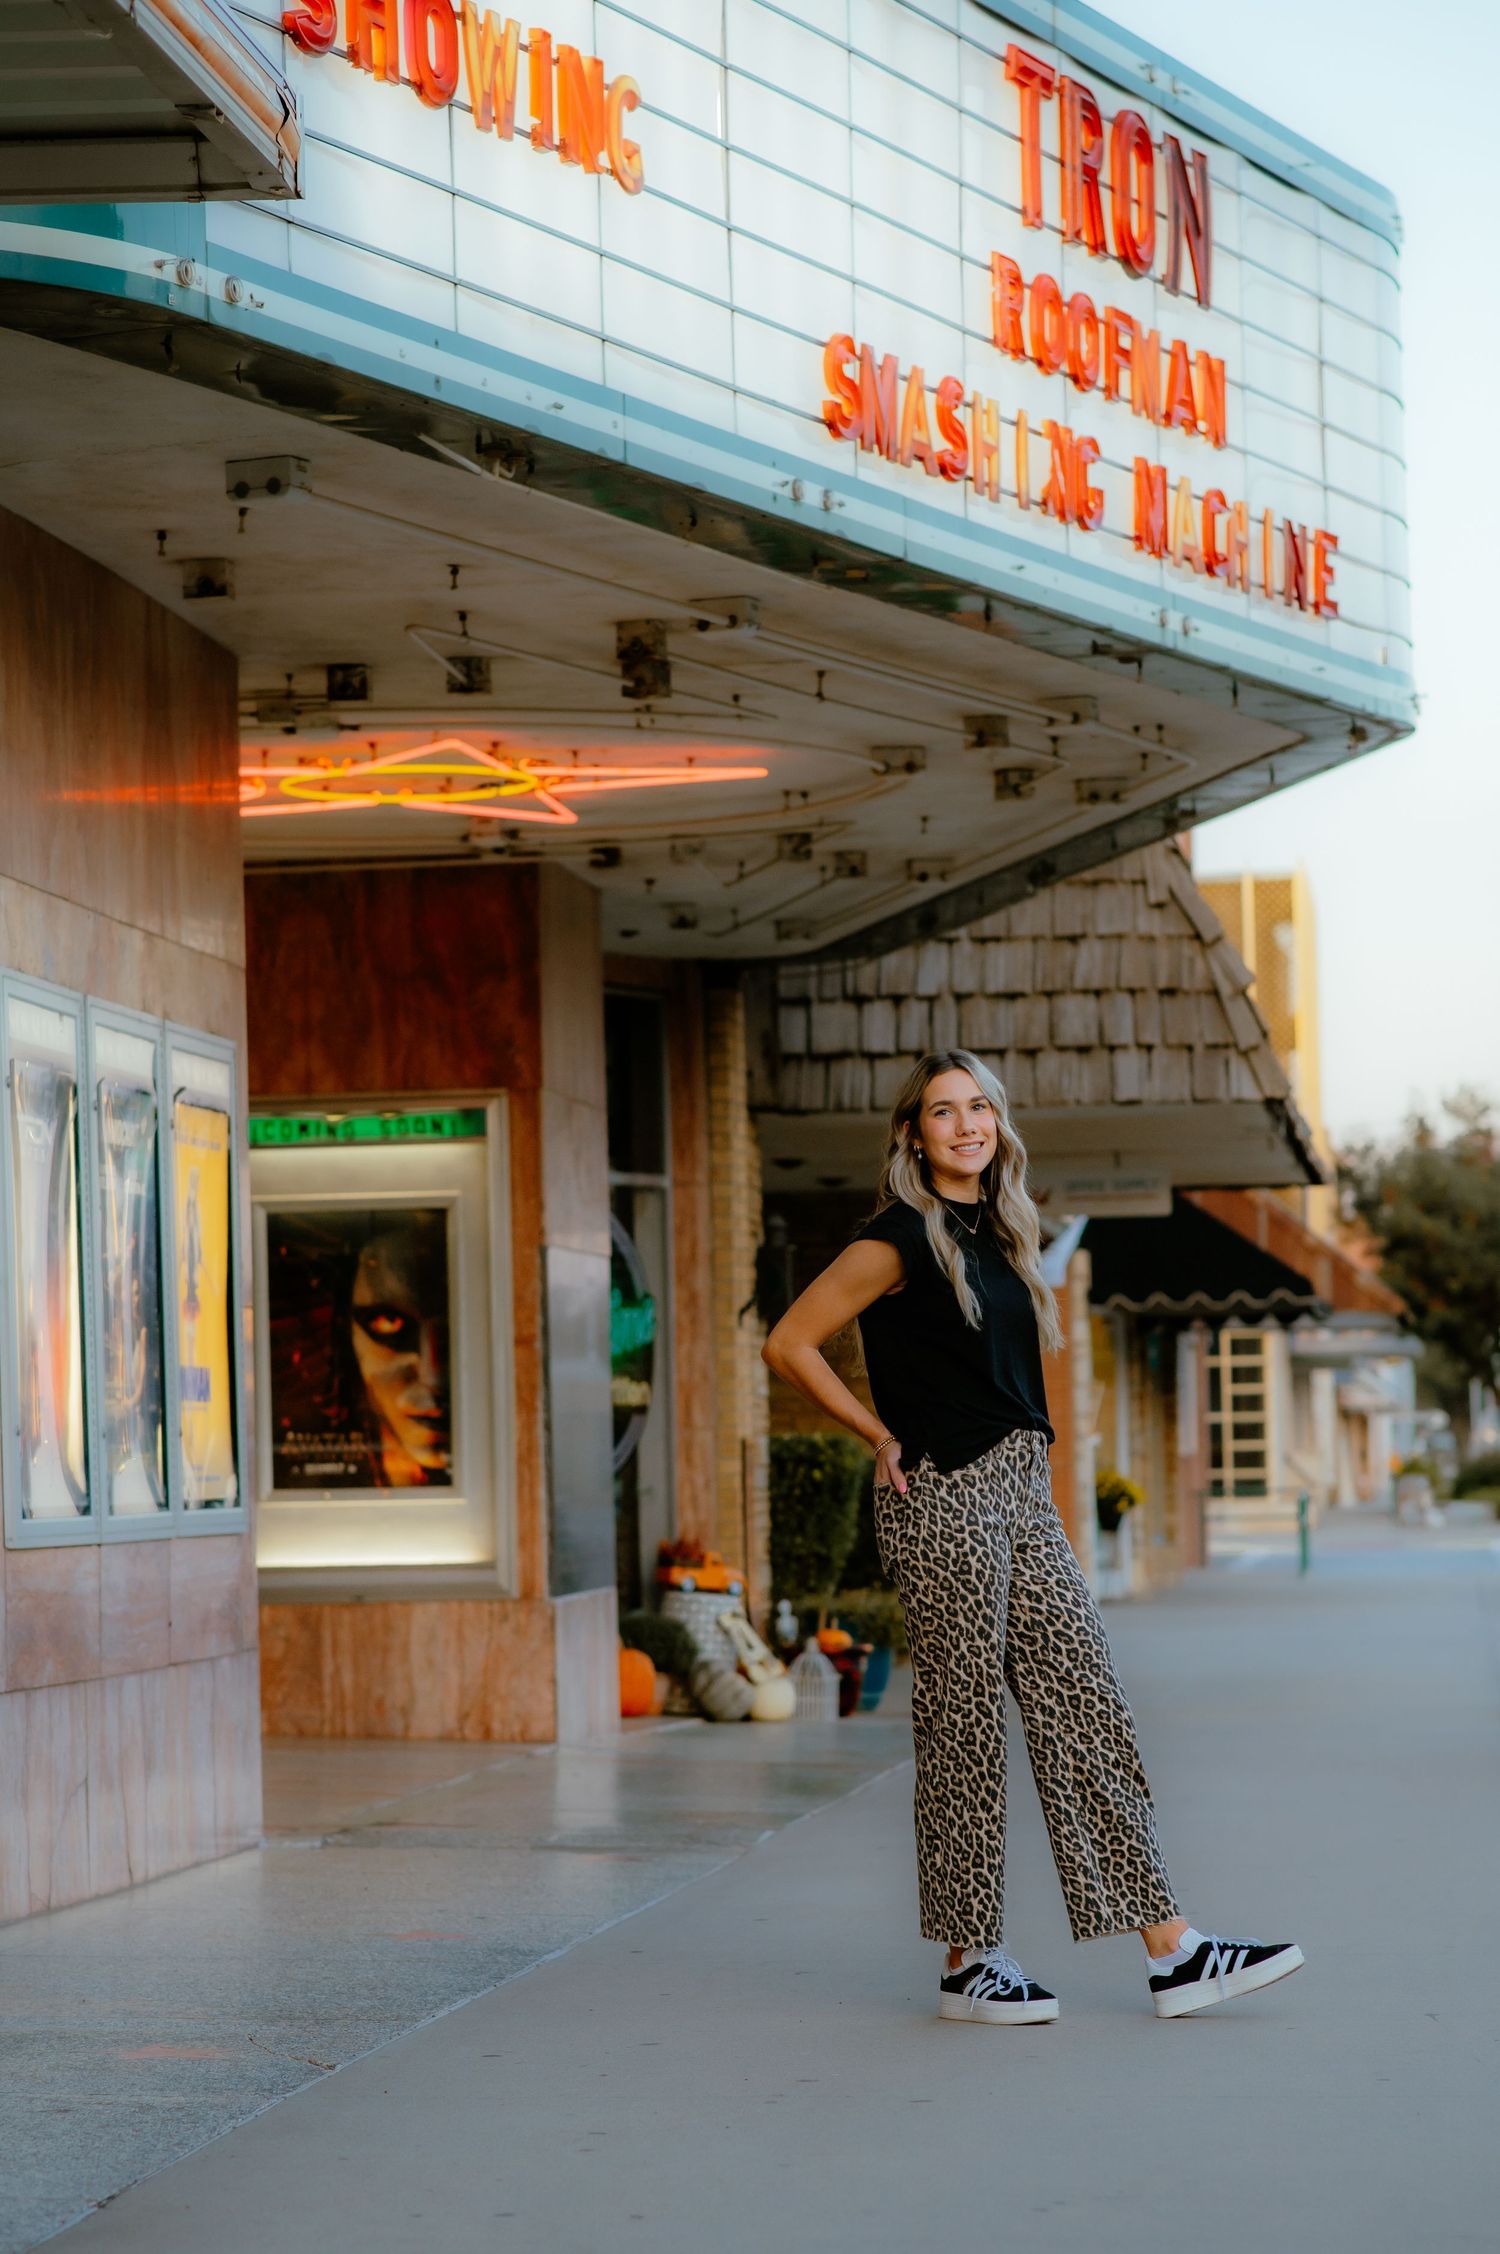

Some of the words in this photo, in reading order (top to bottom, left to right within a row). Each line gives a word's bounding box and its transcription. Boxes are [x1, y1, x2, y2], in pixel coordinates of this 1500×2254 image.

[1005, 42, 1213, 309] TRON
[822, 333, 1105, 531] SMASHING
[1133, 456, 1339, 620] MACHINE
[991, 251, 1227, 449] ROOFMAN
